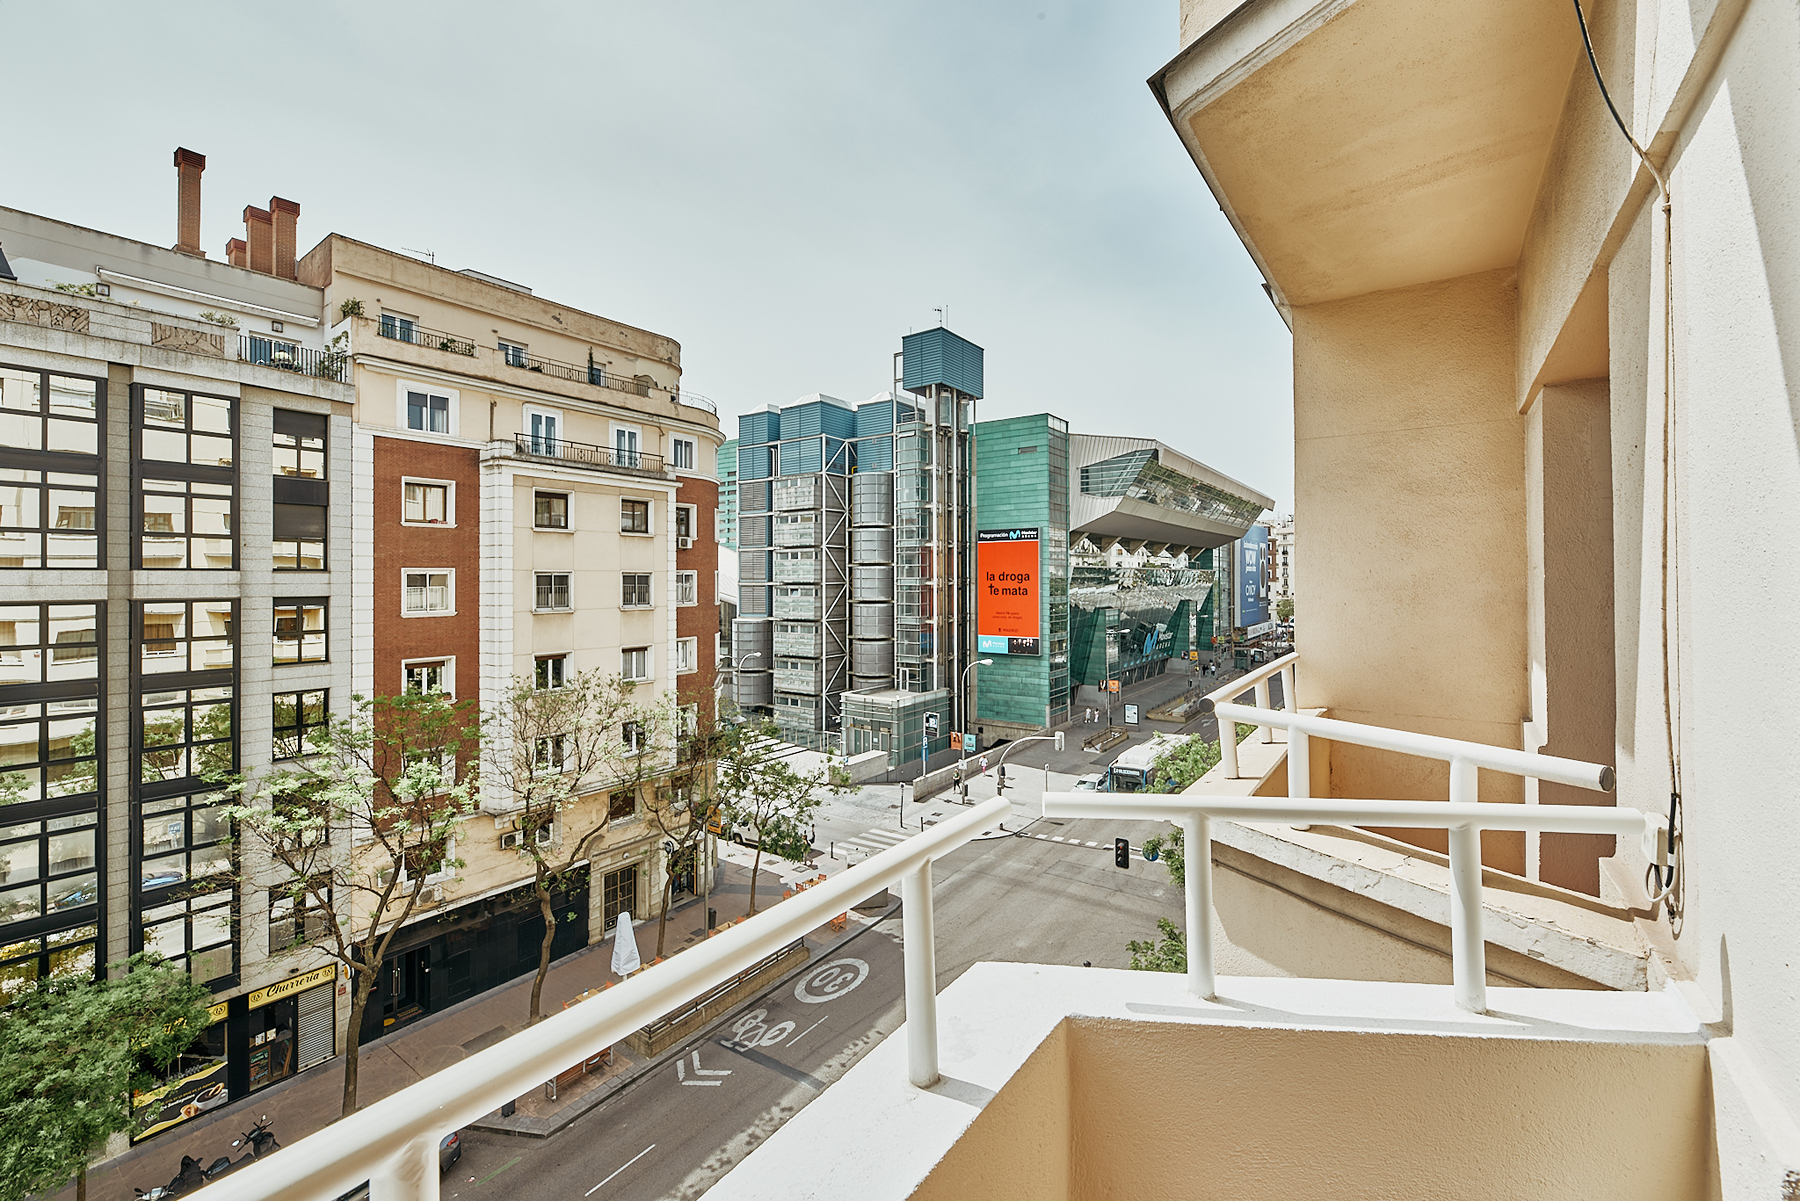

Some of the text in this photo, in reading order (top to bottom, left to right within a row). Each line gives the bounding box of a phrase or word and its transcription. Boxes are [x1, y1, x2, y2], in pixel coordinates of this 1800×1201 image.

[986, 571, 1030, 584] la droga
[1001, 586, 1028, 596] mata
[811, 967, 855, 993] 30
